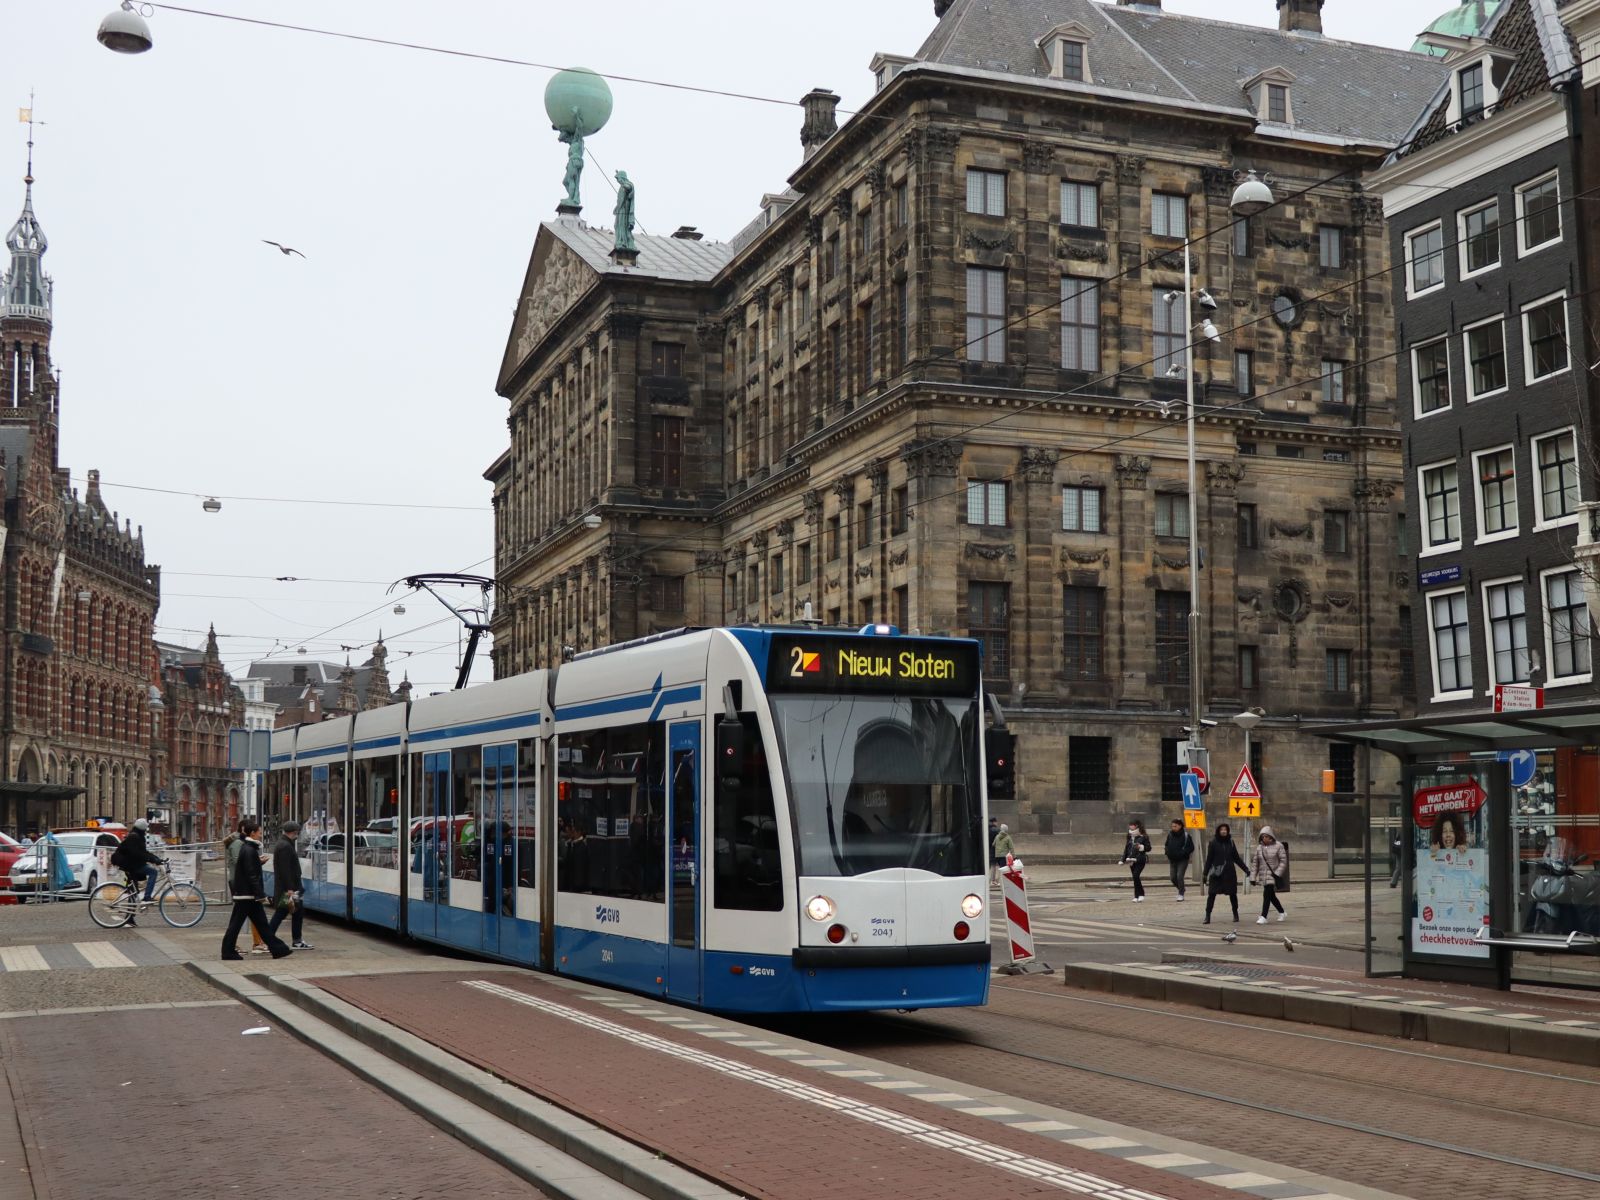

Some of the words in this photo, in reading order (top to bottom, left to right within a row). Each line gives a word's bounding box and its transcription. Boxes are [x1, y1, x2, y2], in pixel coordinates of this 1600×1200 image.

[790, 646, 804, 678] 2
[838, 649, 892, 677] Nieuw
[899, 651, 955, 679] Sloten
[1427, 793, 1443, 804] WAT
[1444, 789, 1464, 802] GAAT
[1419, 803, 1435, 814] HET
[1433, 800, 1464, 812] WORDEN
[607, 908, 620, 923] GVB
[872, 928, 893, 936] 2041
[1419, 923, 1438, 931] Bezoek
[1452, 926, 1466, 934] open
[761, 968, 775, 976] GVB
